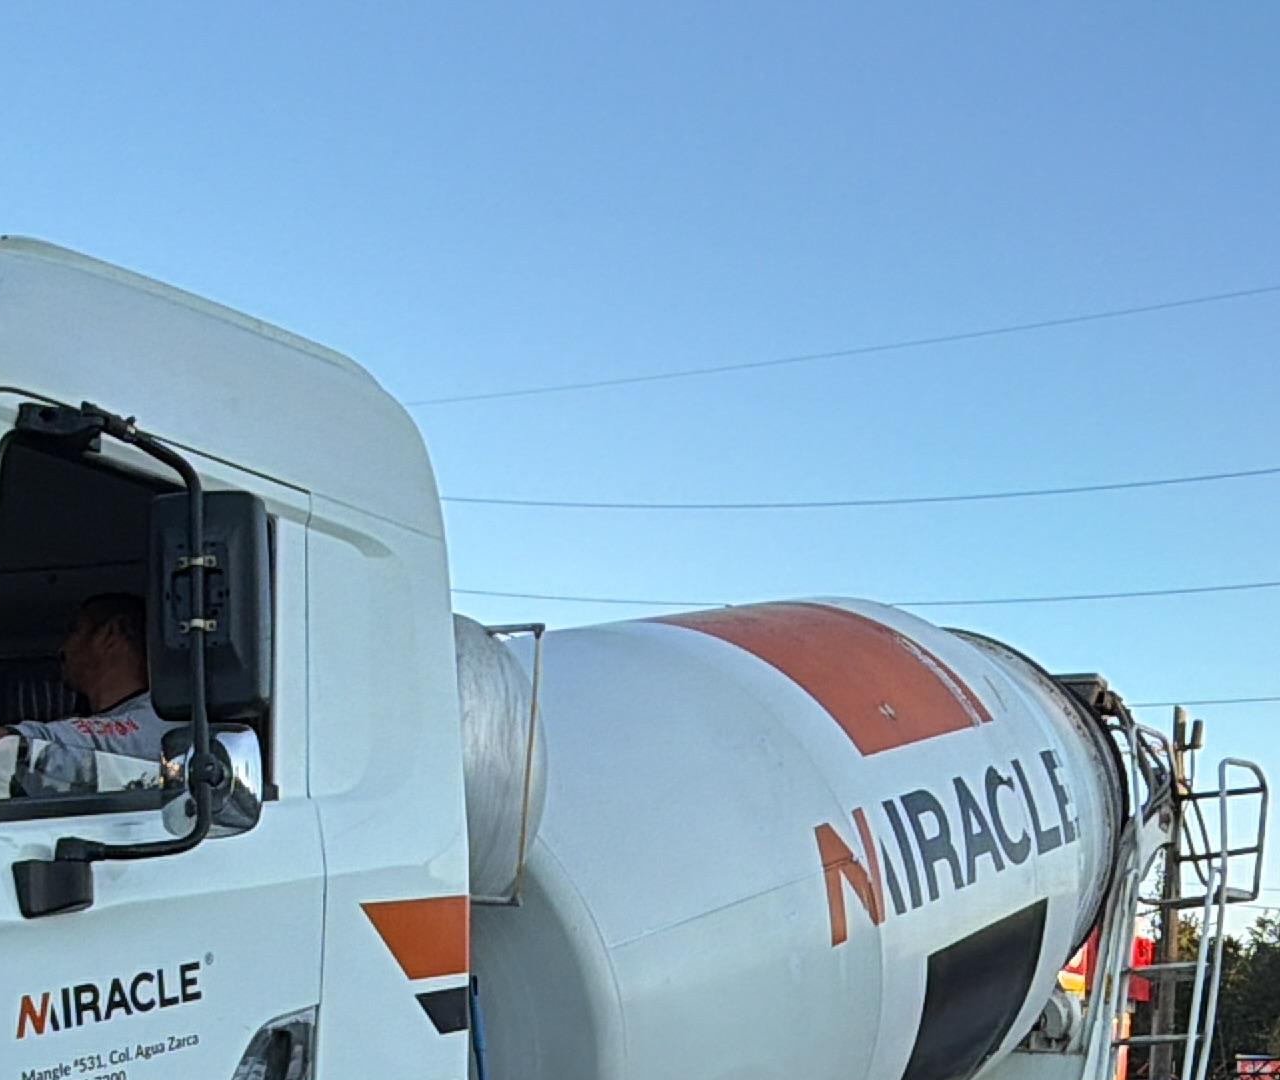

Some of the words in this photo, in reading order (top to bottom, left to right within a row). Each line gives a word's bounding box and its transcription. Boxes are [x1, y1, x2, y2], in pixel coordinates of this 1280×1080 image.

[814, 749, 1080, 948] MIRACLE
[16, 961, 202, 1040] MIRACLE
[109, 1047, 133, 1065] Col.
[134, 1042, 166, 1060] Agua
[167, 1033, 200, 1052] Zarca
